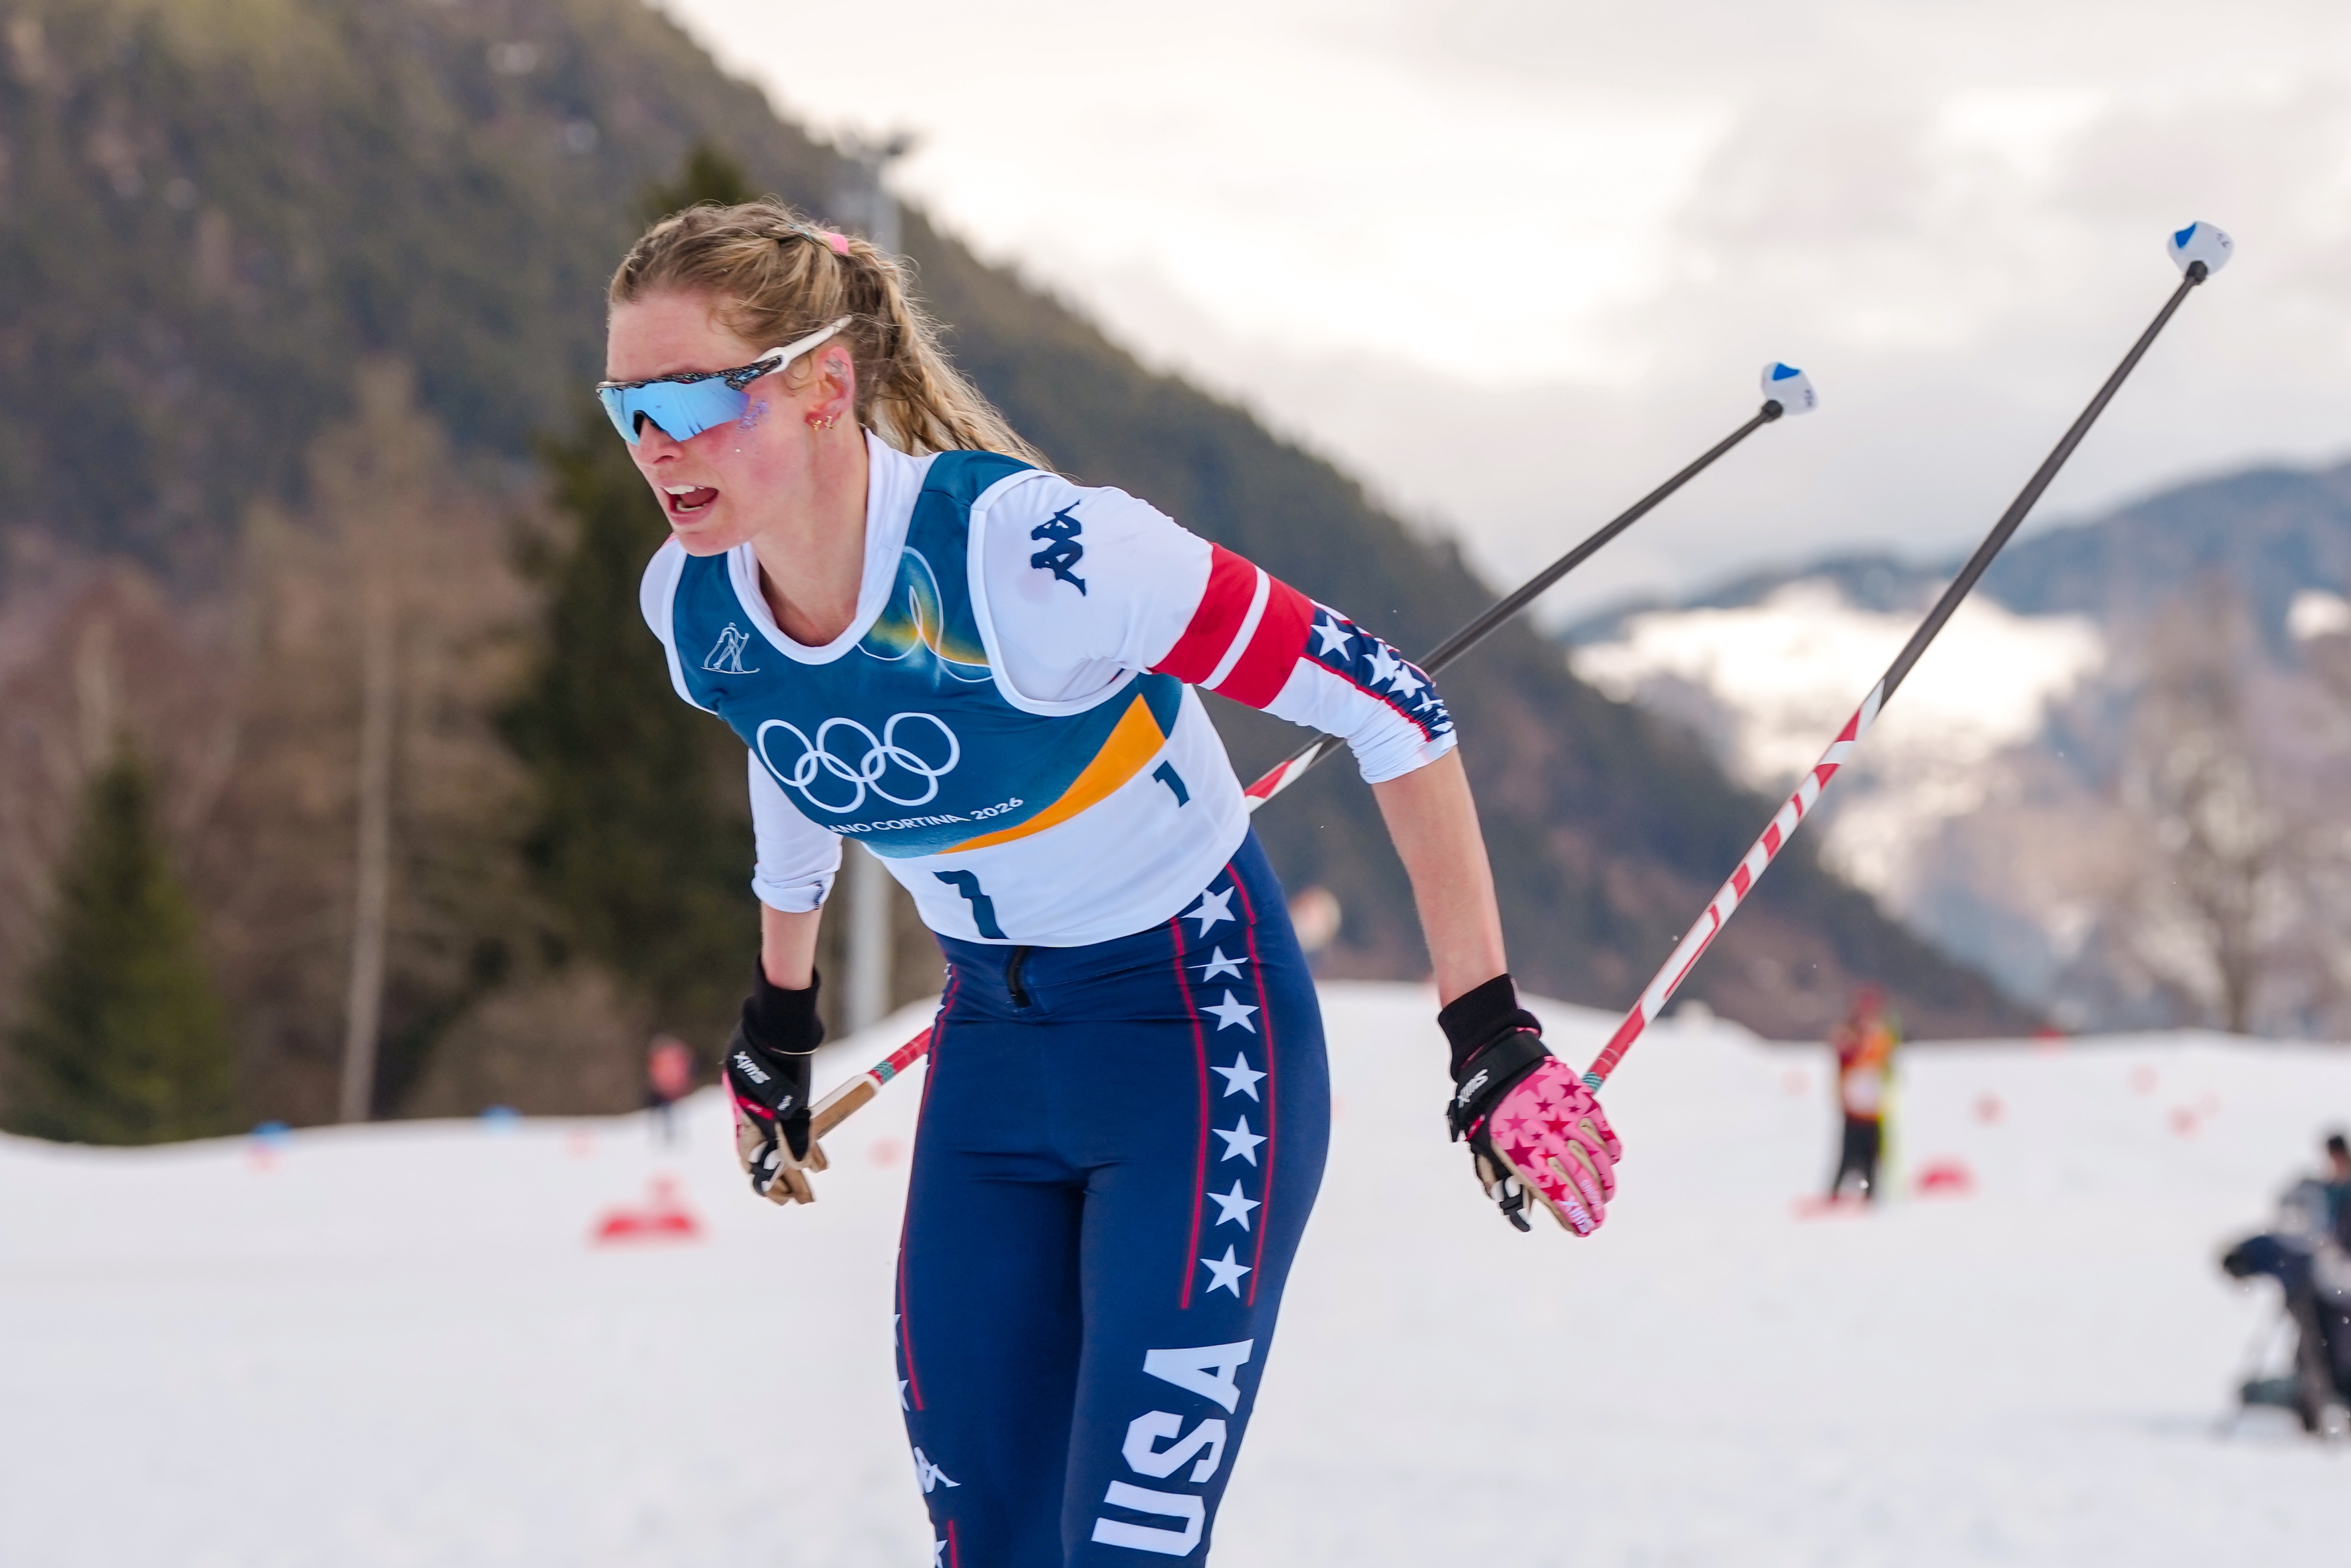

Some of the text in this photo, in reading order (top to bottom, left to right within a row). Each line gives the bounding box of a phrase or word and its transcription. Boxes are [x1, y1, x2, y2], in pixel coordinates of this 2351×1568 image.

[1152, 759, 1189, 808] 1
[871, 814, 972, 831] CORTINA
[970, 797, 1024, 820] 2026
[1091, 1339, 1254, 1557] USA
